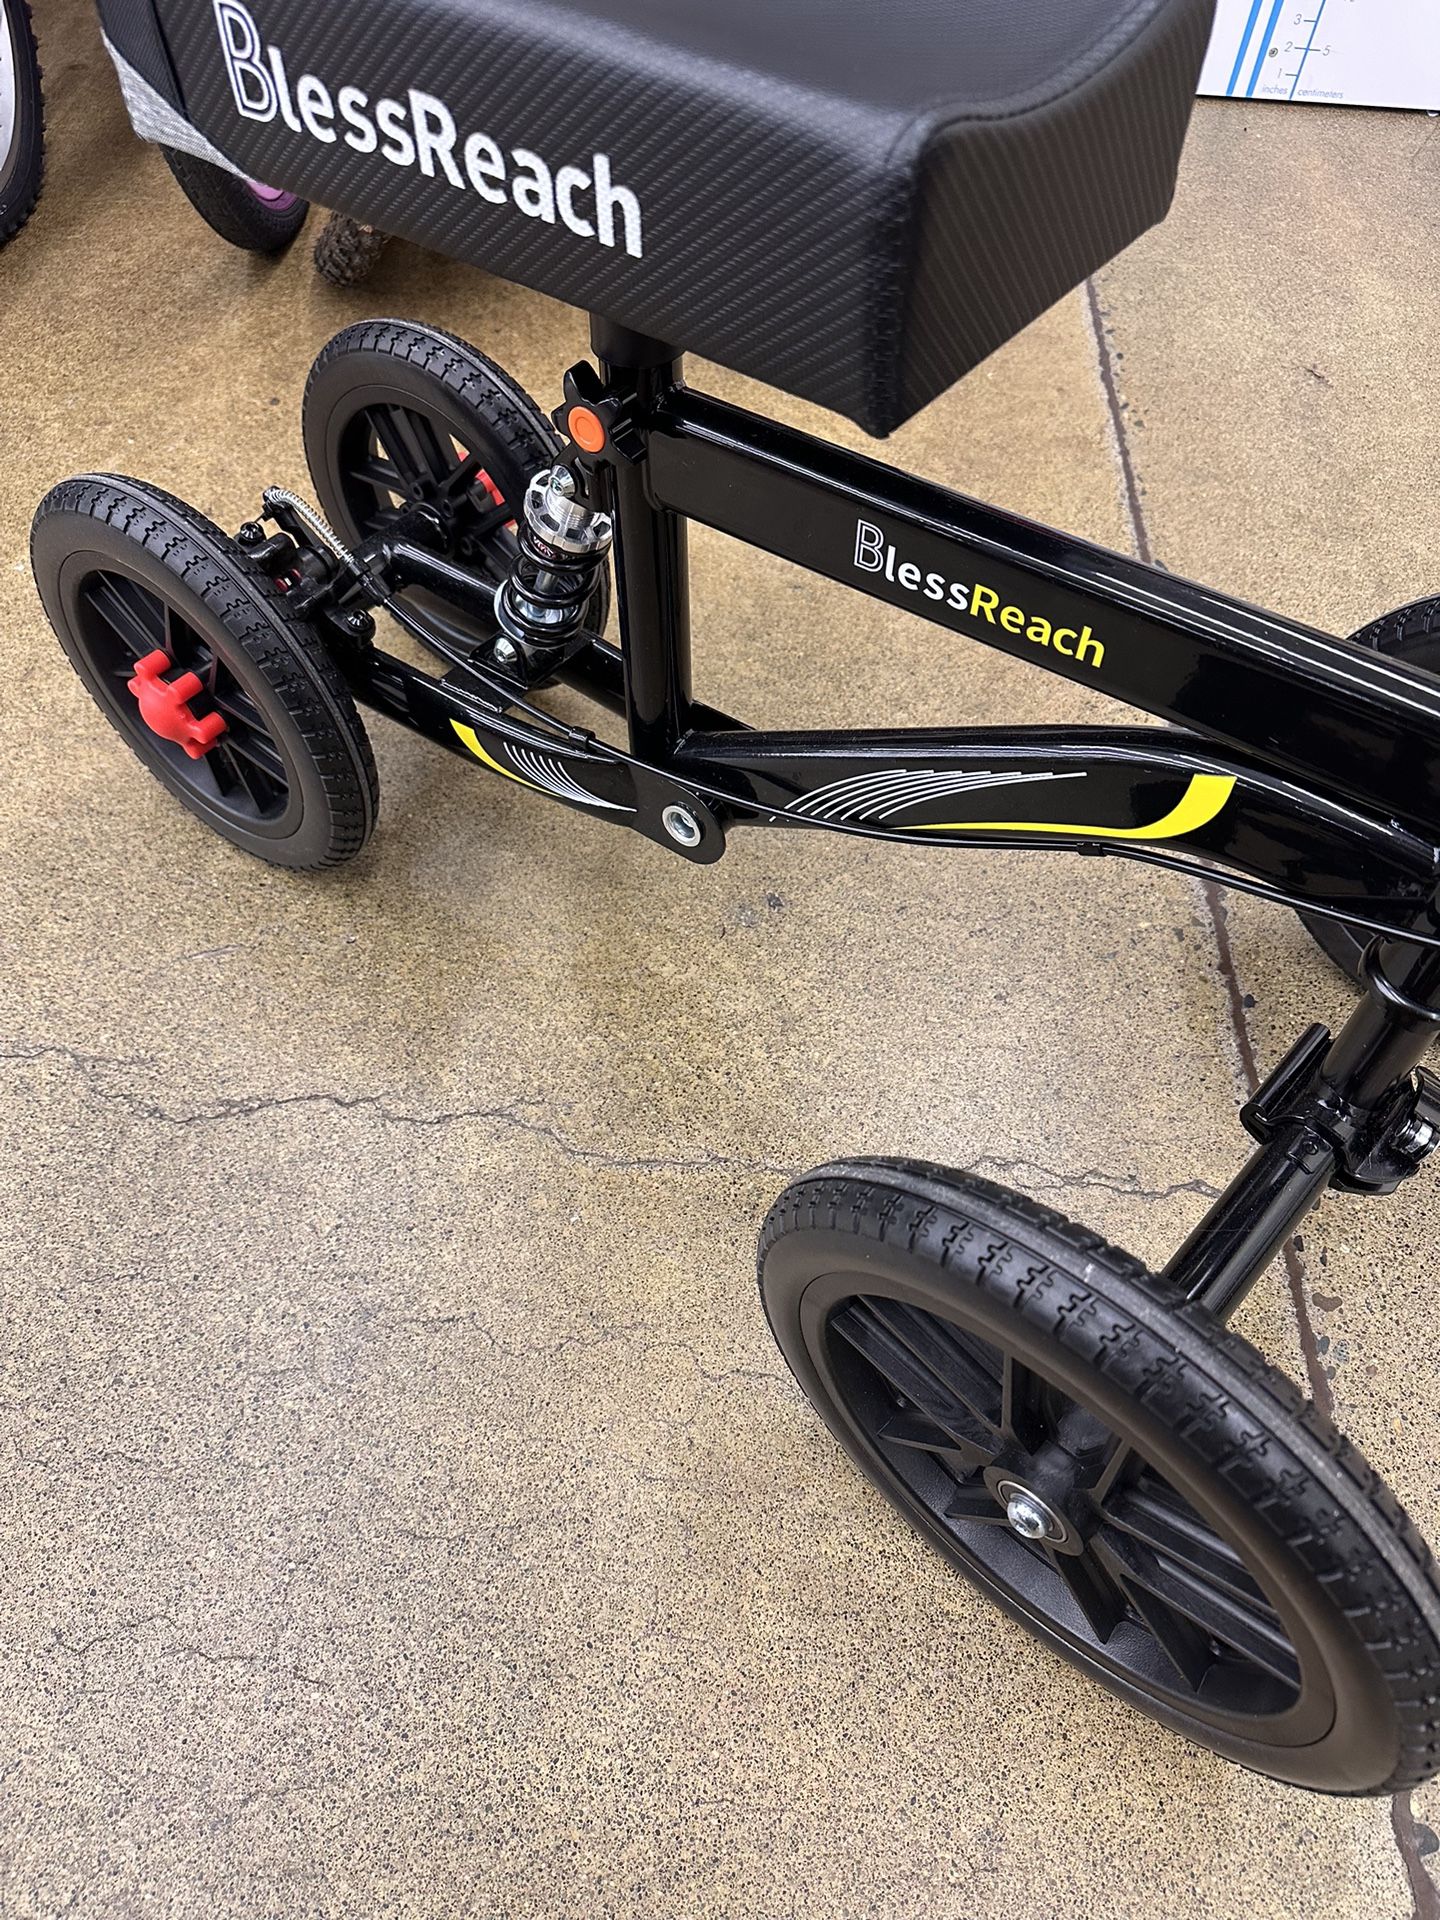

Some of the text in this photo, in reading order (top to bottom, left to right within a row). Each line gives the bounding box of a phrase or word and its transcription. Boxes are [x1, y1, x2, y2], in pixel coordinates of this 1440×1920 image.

[1293, 13, 1303, 26] 3
[1284, 41, 1332, 57] 2 5
[1262, 85, 1344, 99] inches centimeters
[212, 0, 643, 259] BlessReach
[853, 518, 1105, 668] BlessReach
